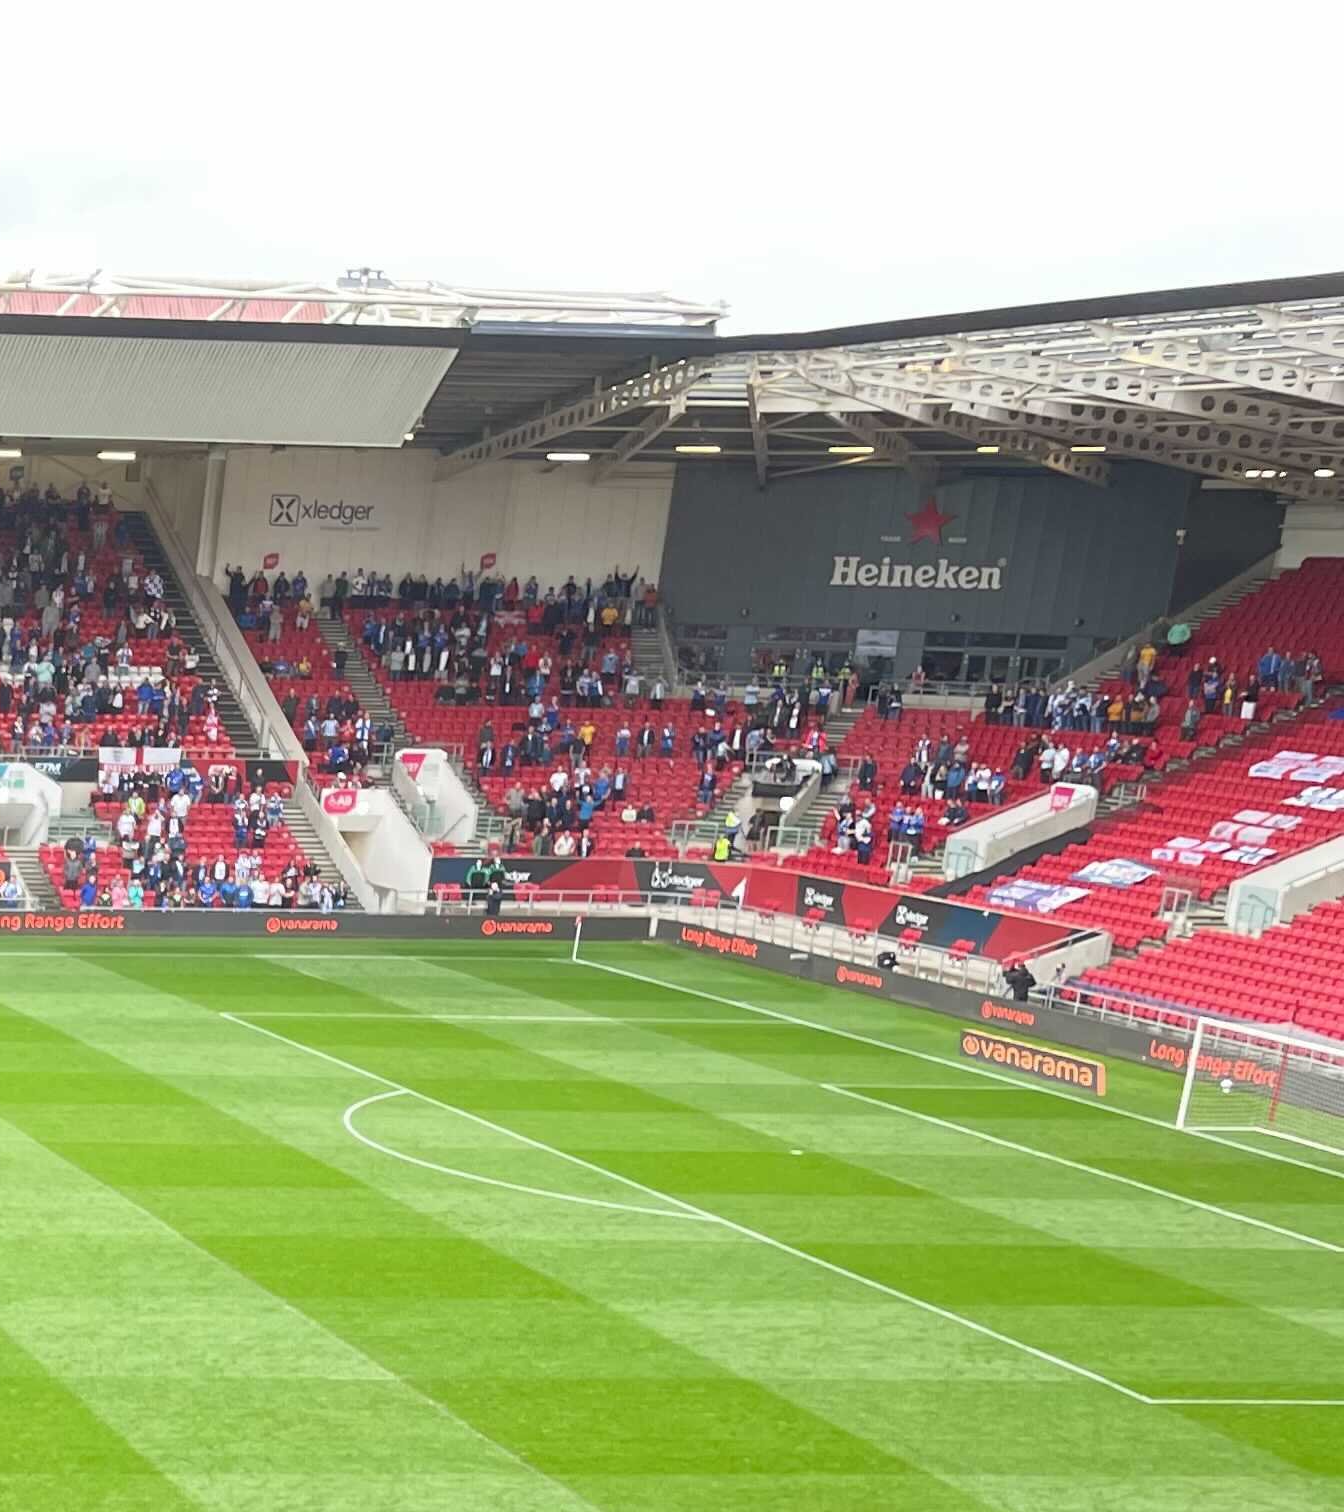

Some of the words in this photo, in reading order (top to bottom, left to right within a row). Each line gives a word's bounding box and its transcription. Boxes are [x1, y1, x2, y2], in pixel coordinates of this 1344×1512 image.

[300, 499, 375, 525] xledger
[829, 556, 1002, 590] Heineken
[24, 914, 75, 932] Range
[78, 914, 124, 930] Effort
[281, 919, 337, 931] vanarama
[497, 921, 552, 934] vanarama
[980, 1040, 1093, 1087] vanarama
[1150, 1039, 1185, 1068] Long
[1186, 1050, 1233, 1078] ange
